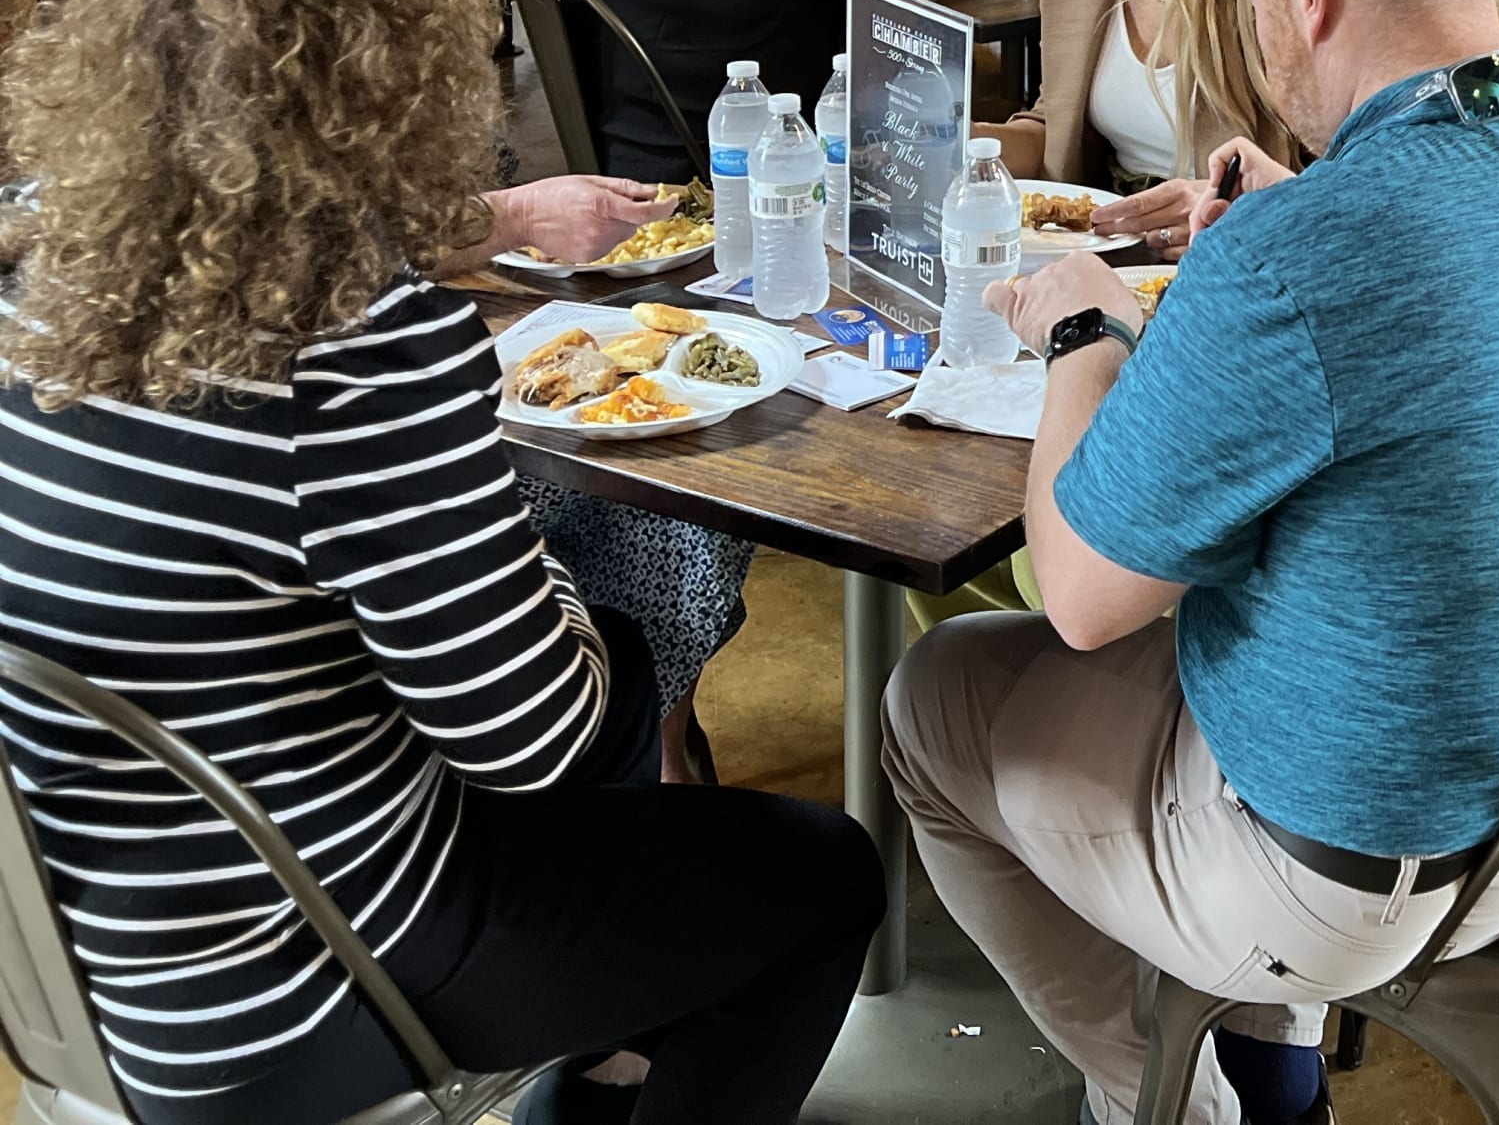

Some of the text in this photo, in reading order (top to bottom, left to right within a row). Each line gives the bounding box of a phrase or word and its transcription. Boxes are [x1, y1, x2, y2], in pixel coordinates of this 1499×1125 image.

[873, 22, 941, 64] CHAMBER
[882, 110, 919, 141] Black
[893, 139, 926, 171] White
[884, 162, 919, 200] Party
[871, 232, 917, 270] TRUIST
